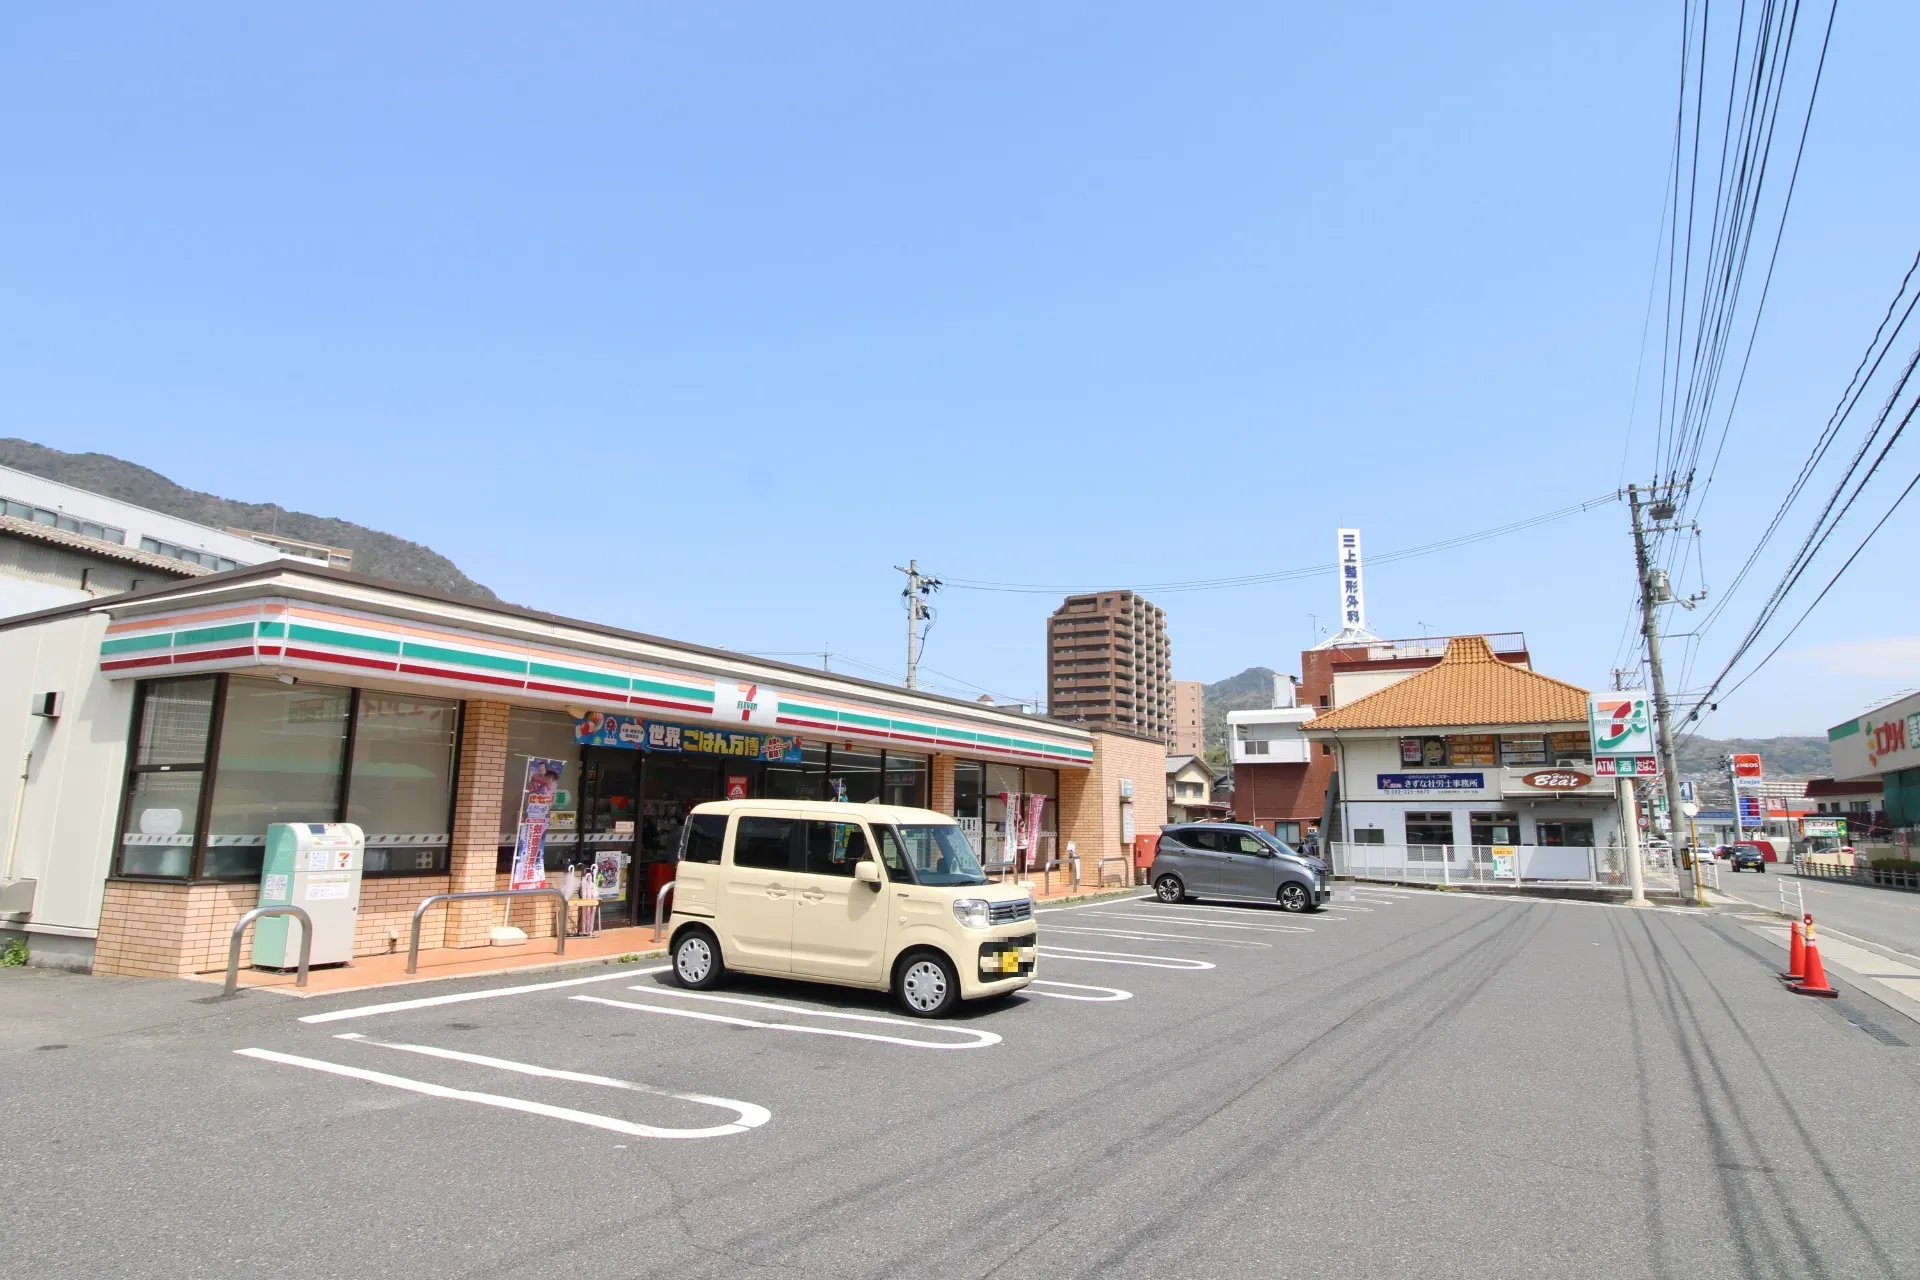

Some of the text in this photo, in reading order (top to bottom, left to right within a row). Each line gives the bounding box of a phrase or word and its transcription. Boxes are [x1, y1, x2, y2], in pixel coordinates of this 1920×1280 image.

[1342, 534, 1360, 624] 三上整形外科
[736, 700, 758, 711] ELEVEN
[648, 723, 760, 757] 世界 ごはん万博
[1597, 760, 1615, 772] ATM
[1619, 760, 1632, 772] 酒
[1636, 759, 1656, 772] たばこ
[1404, 779, 1478, 789] きずな社労士事務所
